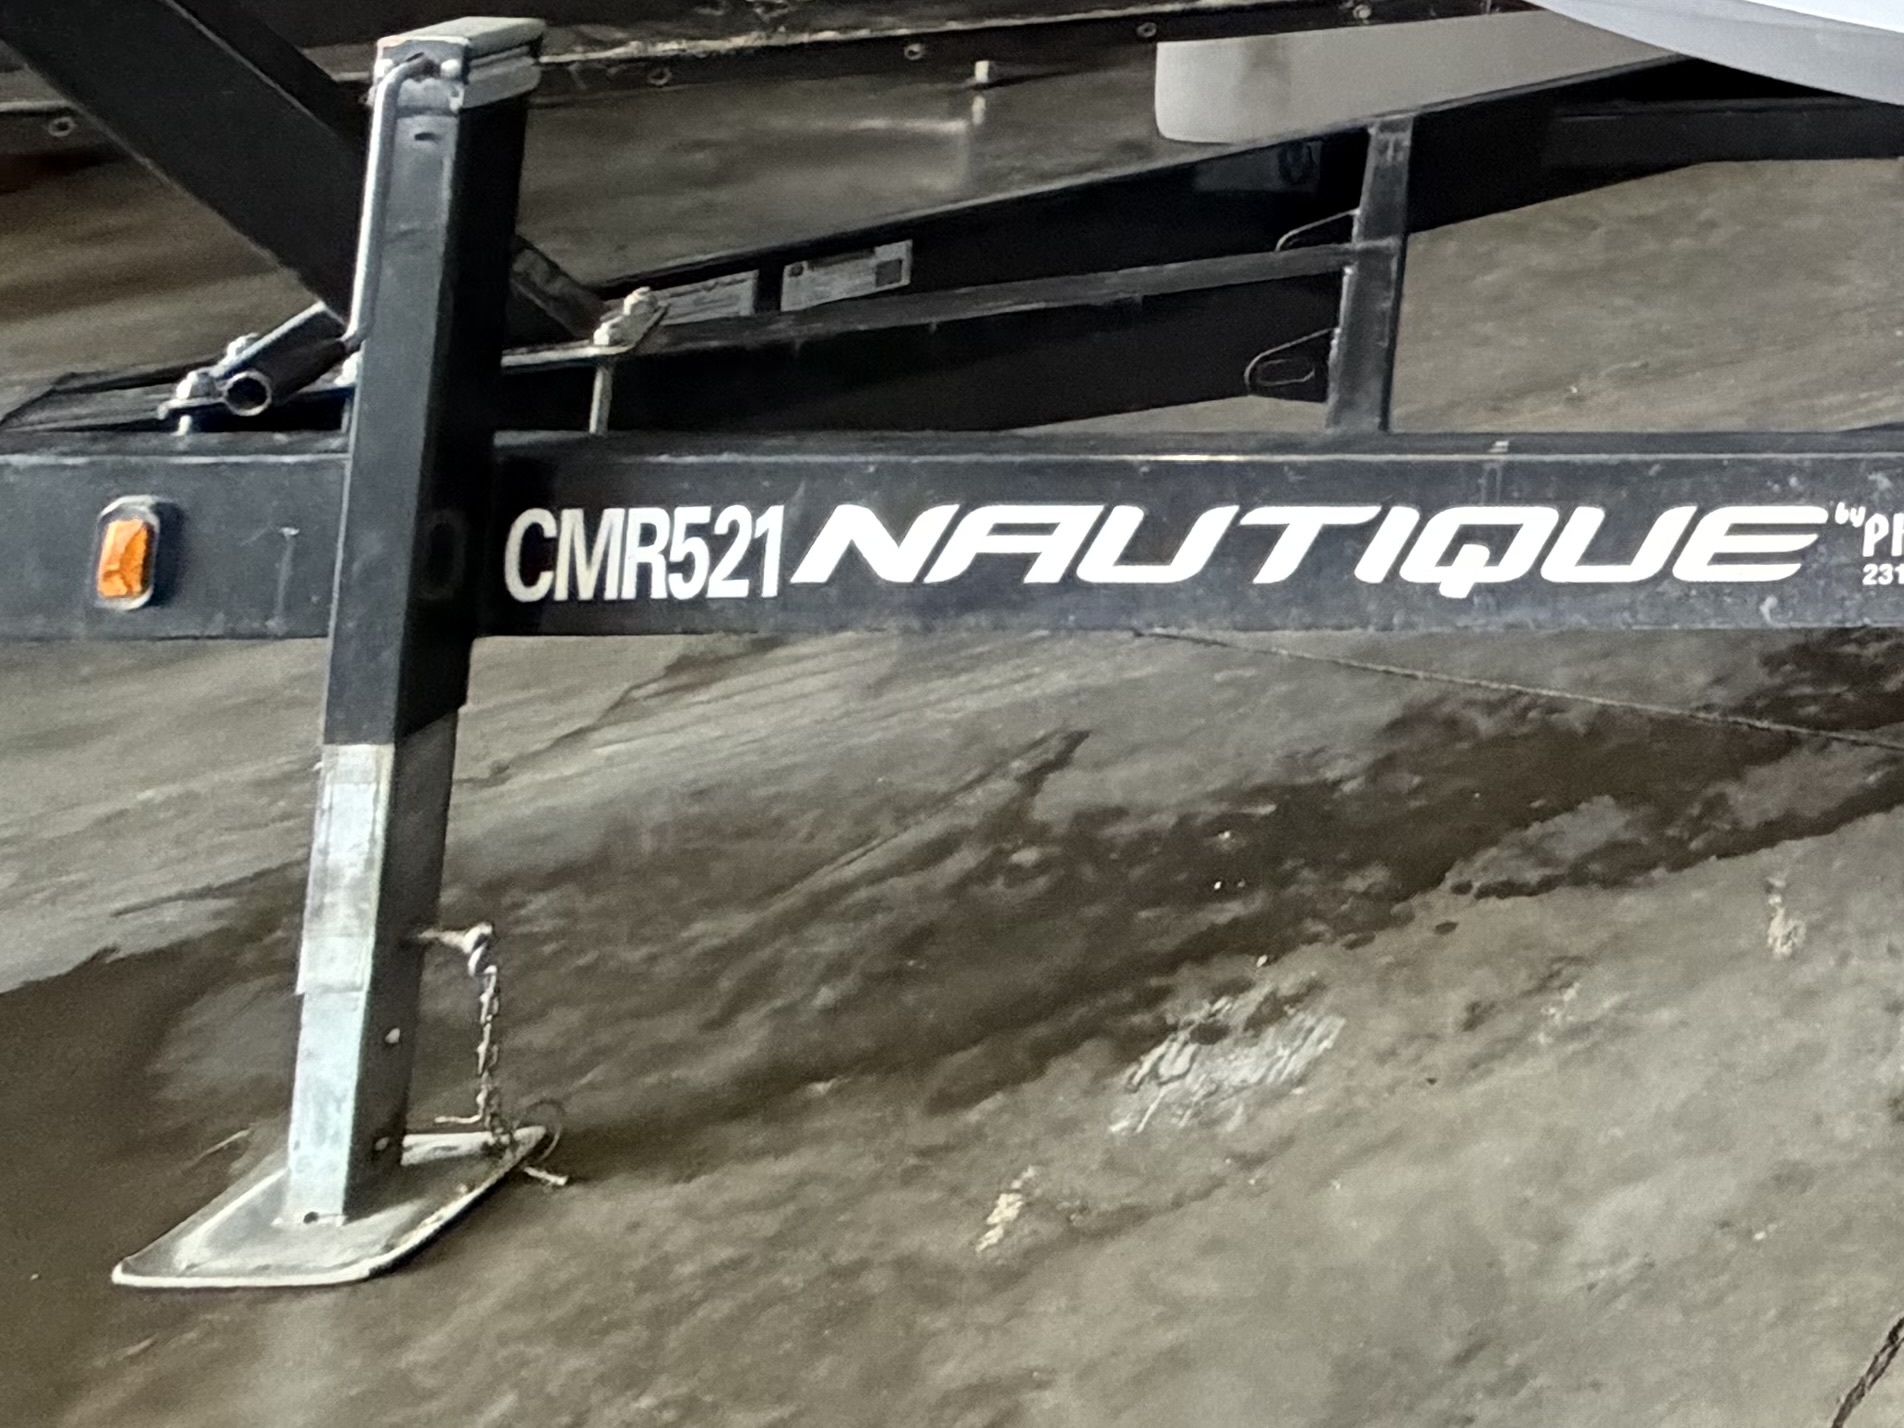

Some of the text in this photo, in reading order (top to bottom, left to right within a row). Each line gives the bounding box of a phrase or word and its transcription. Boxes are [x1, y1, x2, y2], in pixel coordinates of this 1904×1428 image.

[1835, 502, 1866, 528] by
[505, 504, 1828, 603] CMR521 NAUTIQUE
